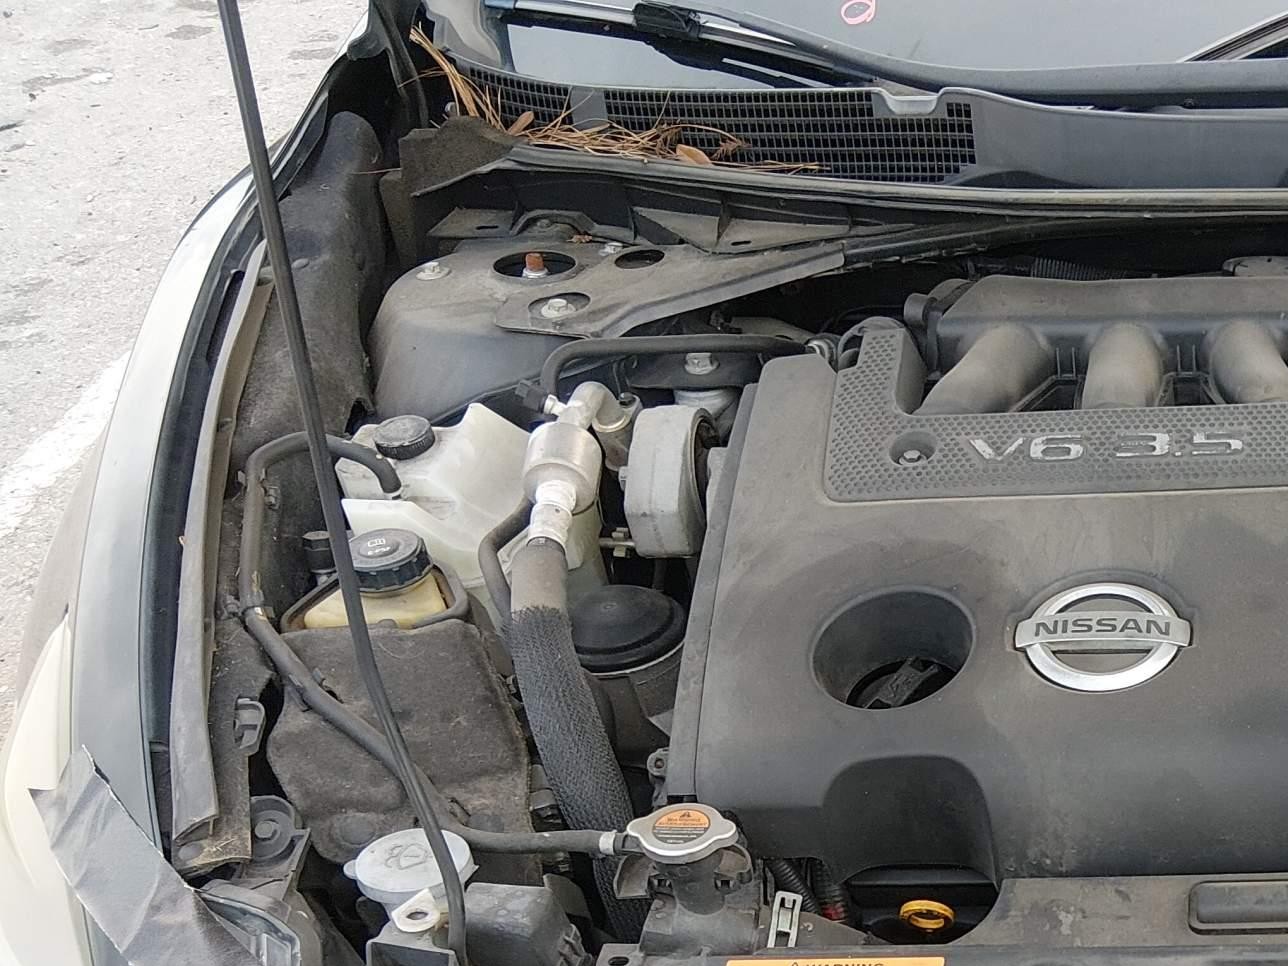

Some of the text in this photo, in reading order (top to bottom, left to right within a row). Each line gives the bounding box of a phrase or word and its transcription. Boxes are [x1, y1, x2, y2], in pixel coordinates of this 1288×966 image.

[968, 431, 1243, 460] V6 3.5
[1034, 617, 1171, 637] NISSAN
